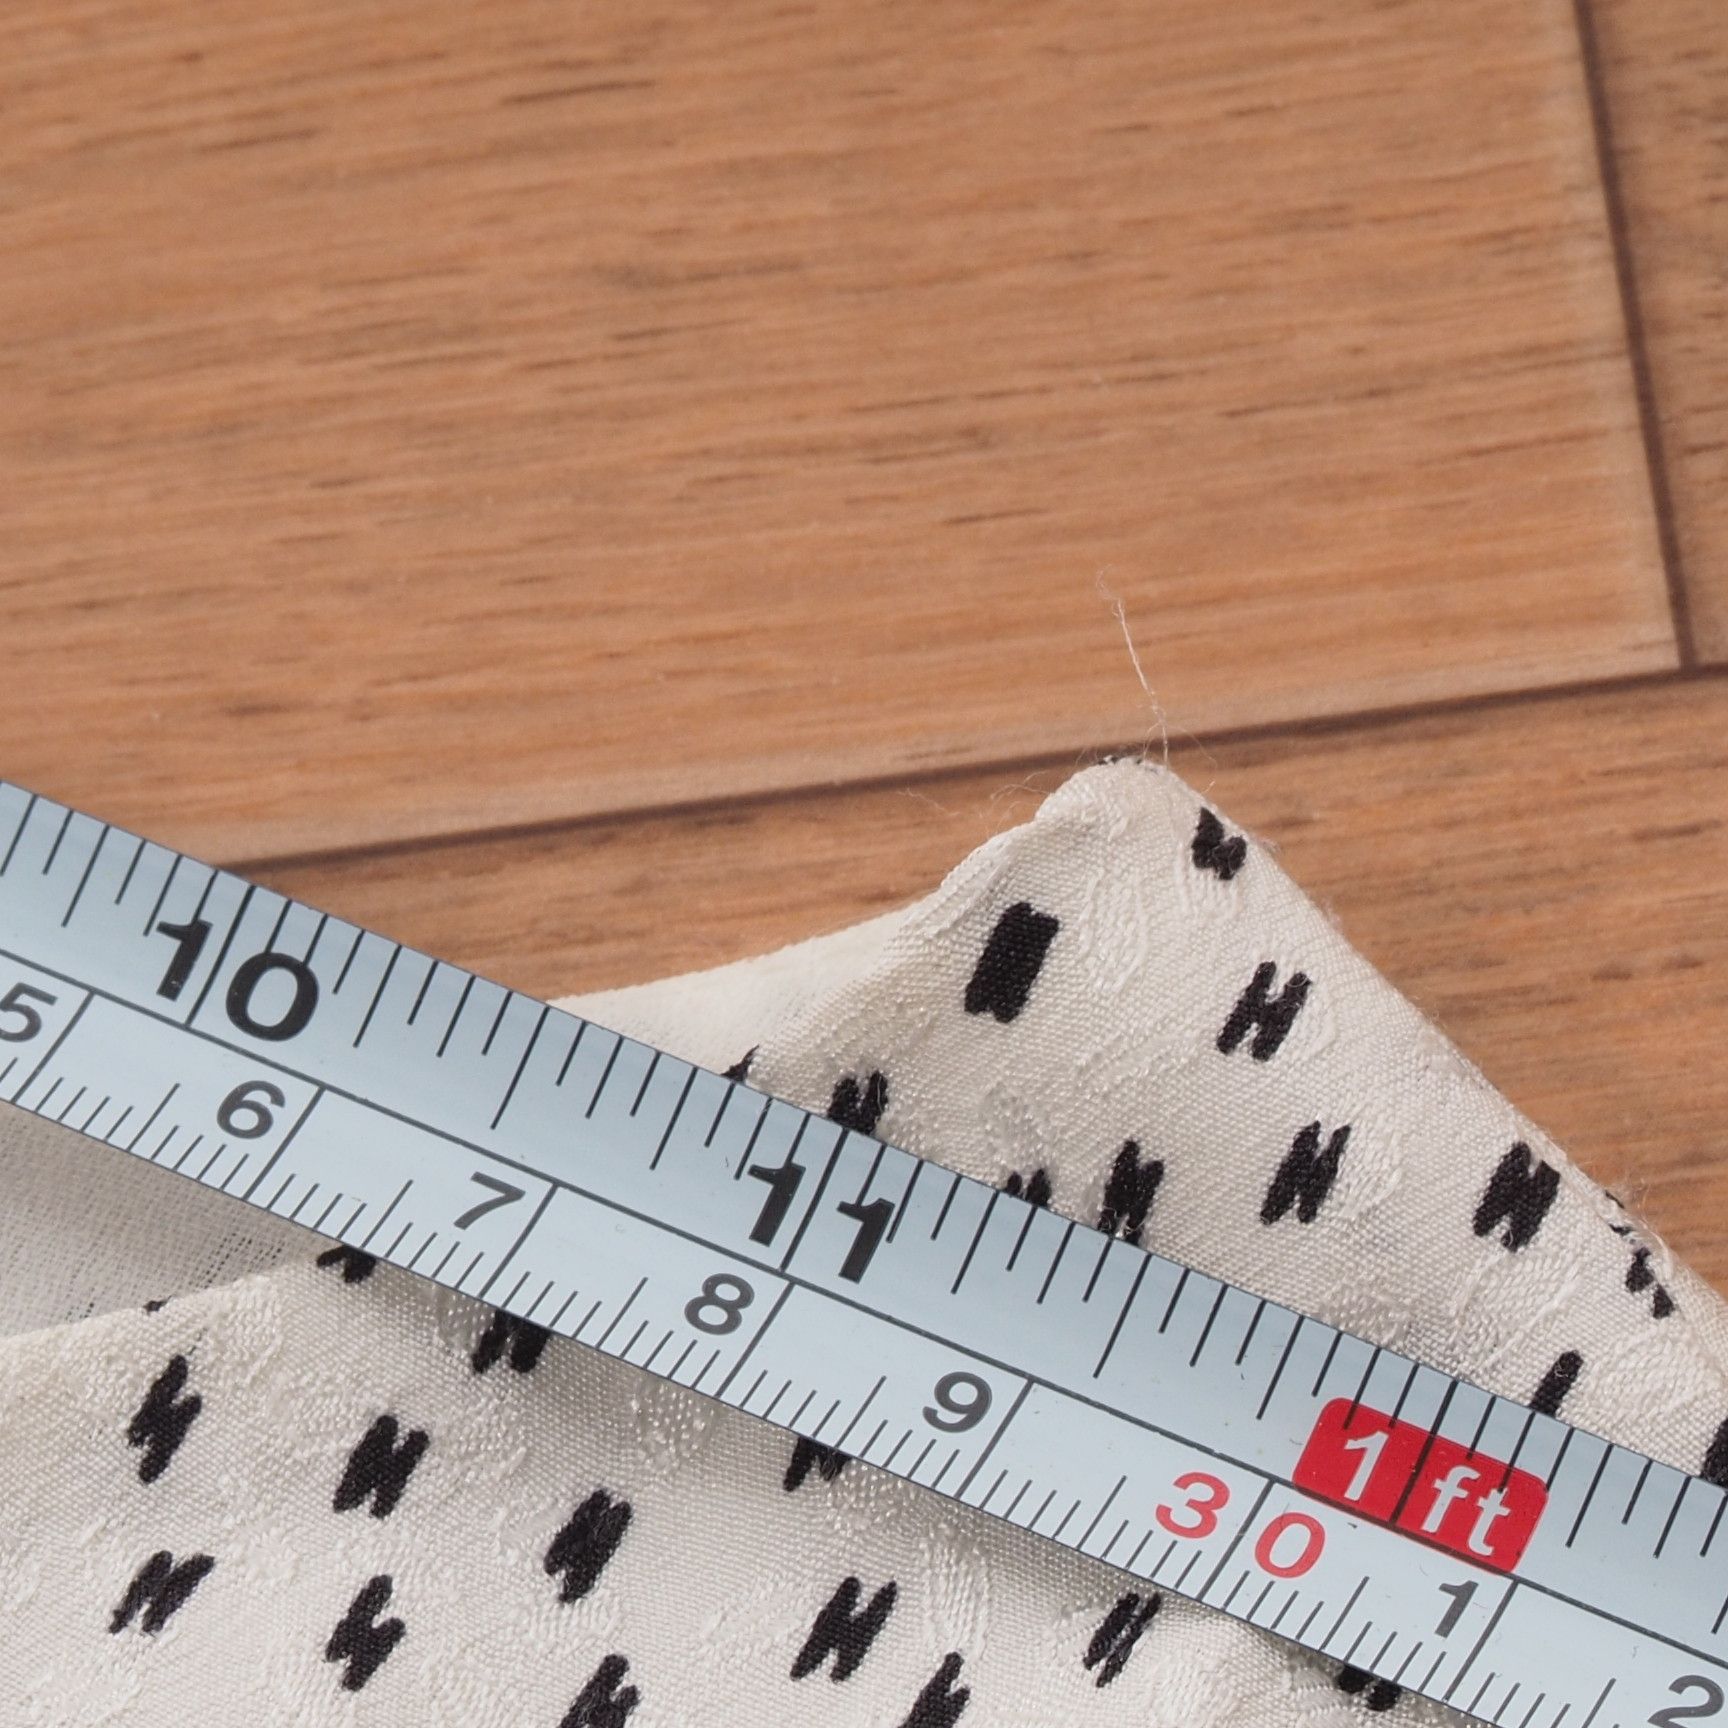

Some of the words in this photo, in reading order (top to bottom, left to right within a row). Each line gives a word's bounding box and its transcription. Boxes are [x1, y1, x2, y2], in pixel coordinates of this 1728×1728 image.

[155, 915, 320, 1042] 10
[0, 982, 58, 1044] 5
[215, 1080, 287, 1140] 6
[451, 1172, 527, 1233] 7
[746, 1161, 896, 1284] 11
[684, 1272, 756, 1336] 8
[922, 1371, 993, 1434] 9
[1341, 1430, 1389, 1502] 1
[1428, 1465, 1513, 1558] ft
[1154, 1472, 1326, 1580] 30
[1437, 1579, 1480, 1640] 1
